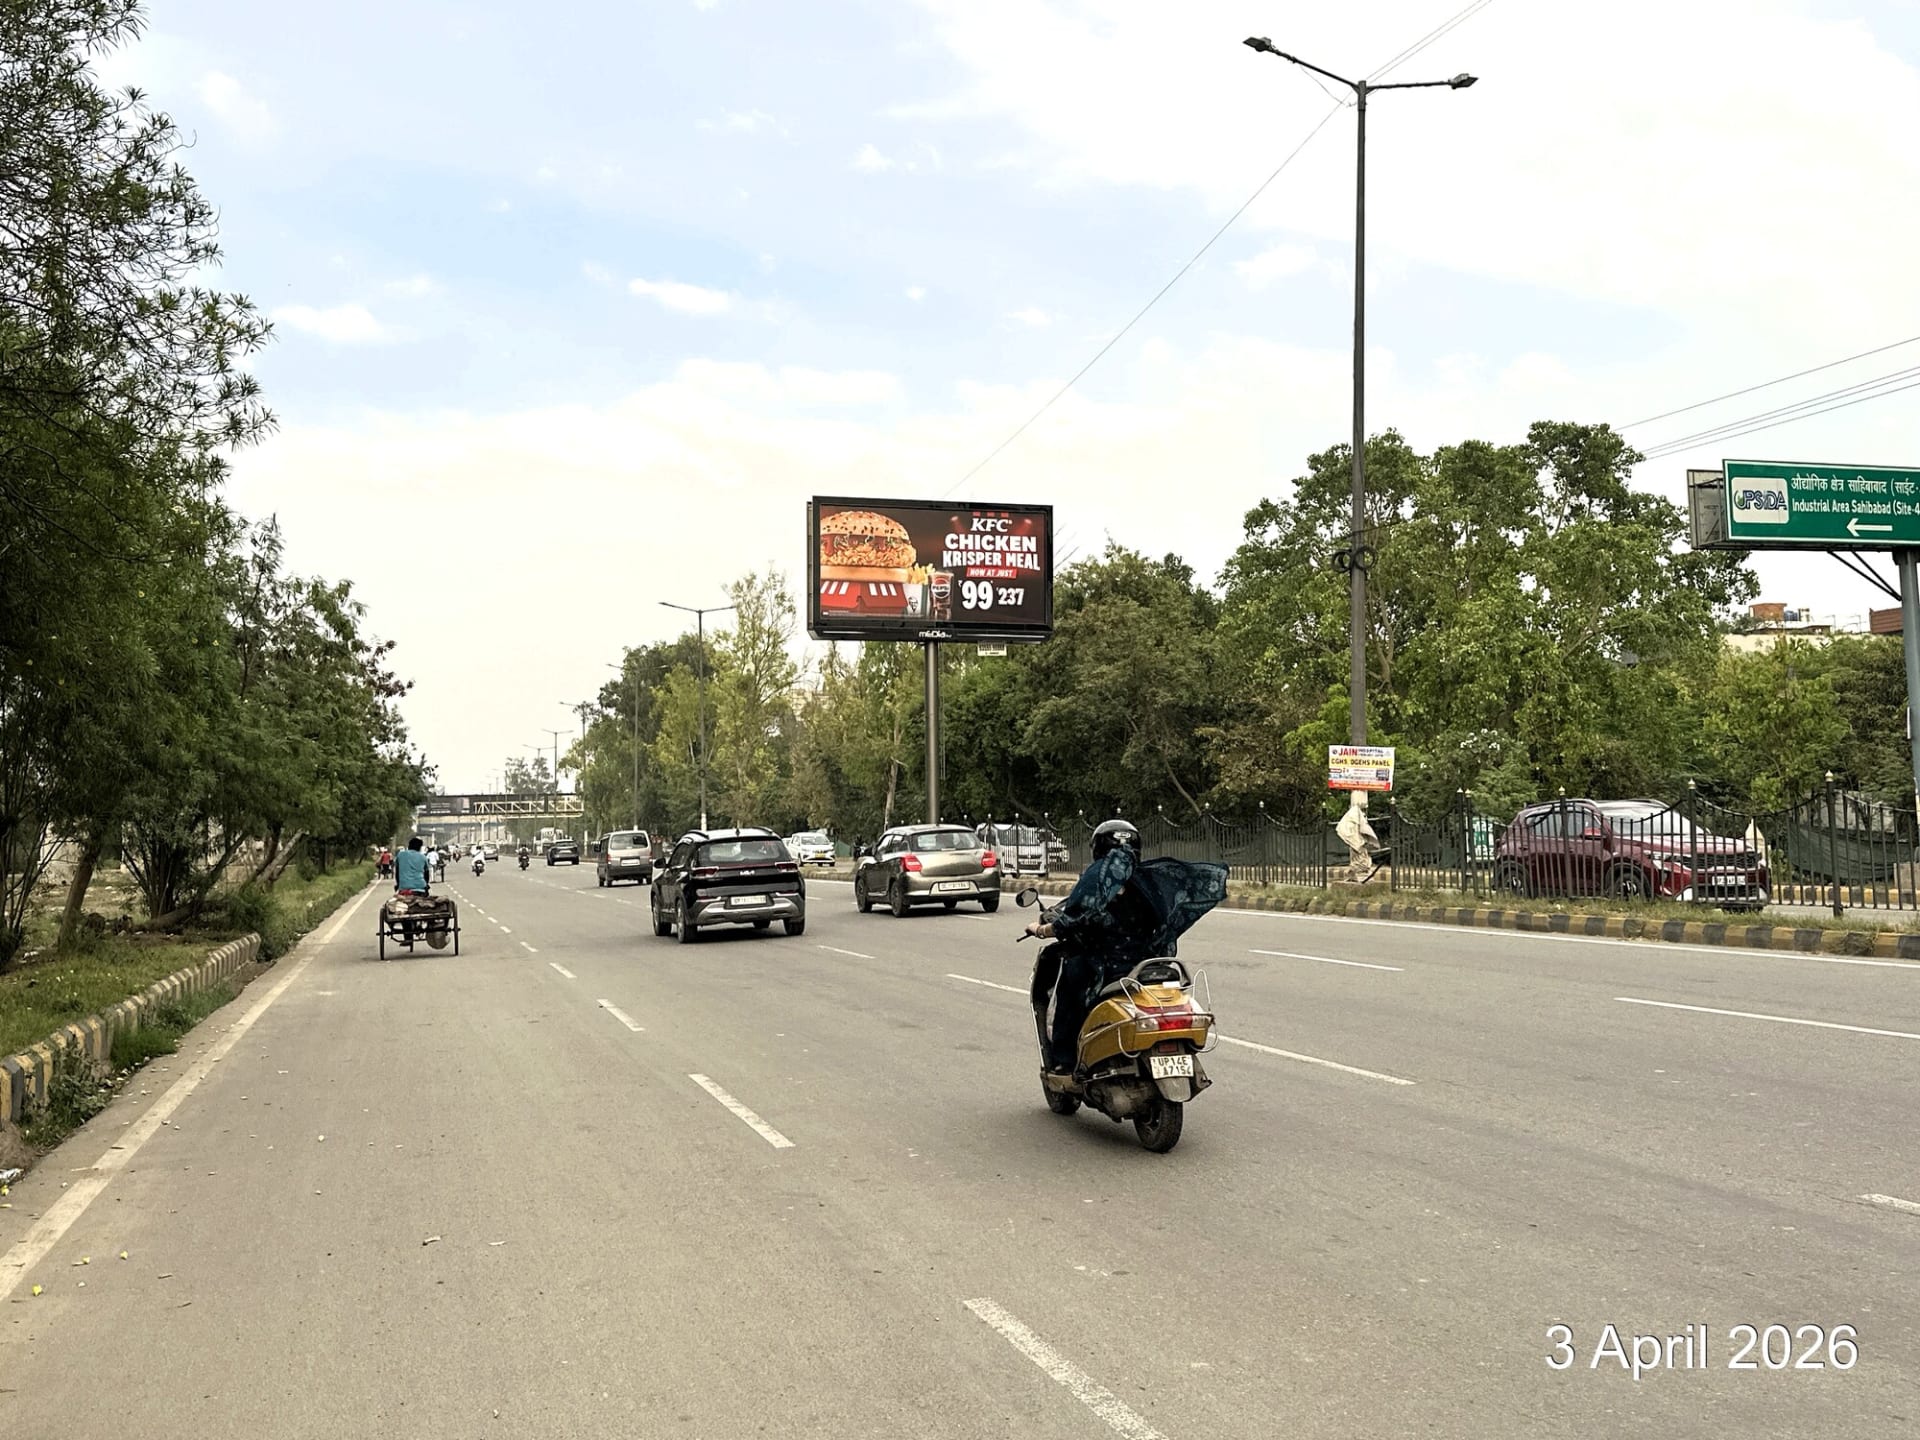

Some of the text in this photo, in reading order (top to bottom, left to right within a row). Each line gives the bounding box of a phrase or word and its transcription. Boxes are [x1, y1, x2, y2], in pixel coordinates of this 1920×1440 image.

[1790, 473, 1828, 491] औद्योगिक
[1830, 474, 1844, 492] क्षेत्र
[1847, 475, 1887, 494] साहिबाबाद
[1792, 498, 1830, 513] Industrial
[1831, 499, 1850, 513] Area
[1851, 499, 1891, 514] Sahibabad
[970, 518, 1012, 532] KFC
[945, 533, 1037, 552] CHICKEN
[942, 550, 1041, 571] KRISPER MEAL
[970, 568, 1013, 577] NOW AT JUST
[1338, 747, 1358, 756] JAIN
